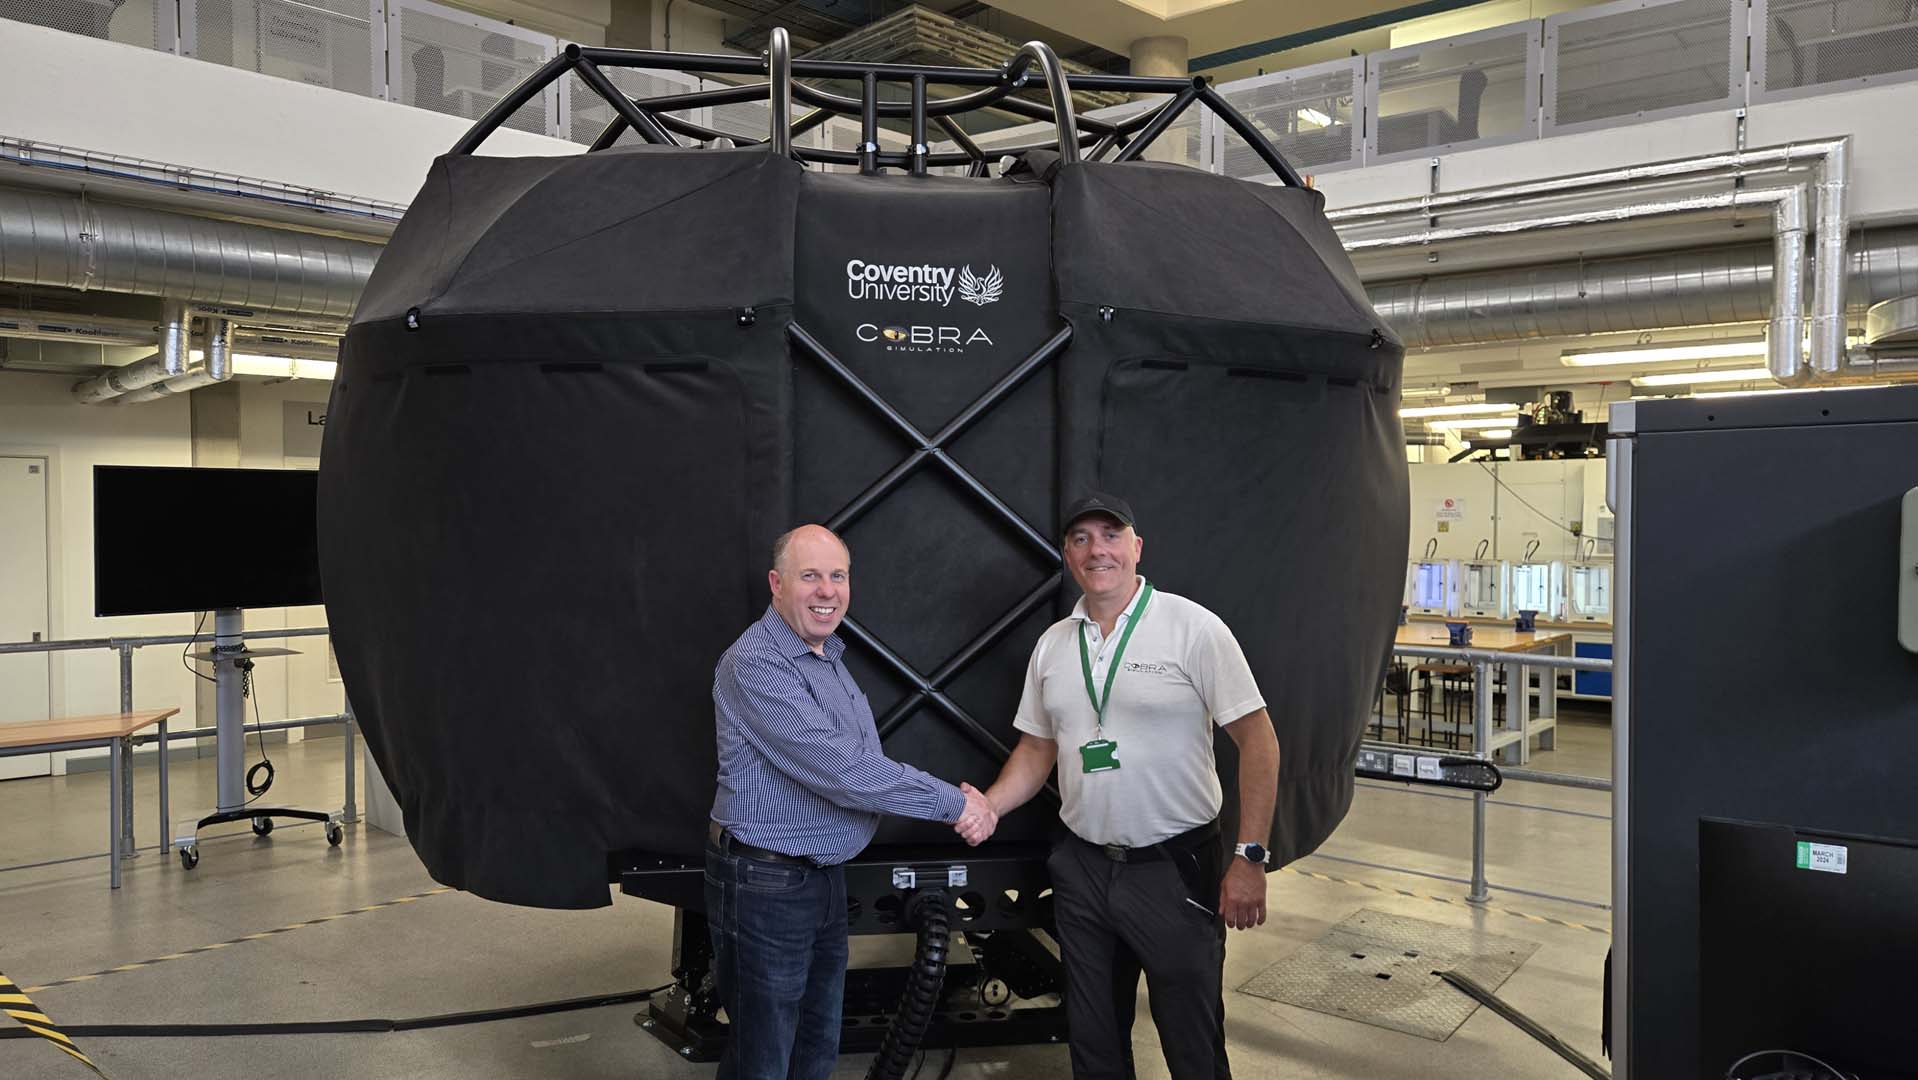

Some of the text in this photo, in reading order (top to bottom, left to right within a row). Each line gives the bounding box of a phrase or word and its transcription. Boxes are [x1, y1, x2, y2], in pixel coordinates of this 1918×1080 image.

[847, 260, 955, 290] Coventry
[849, 279, 955, 307] University
[886, 345, 964, 353] SIMULATION
[1812, 849, 1834, 858] MARCH
